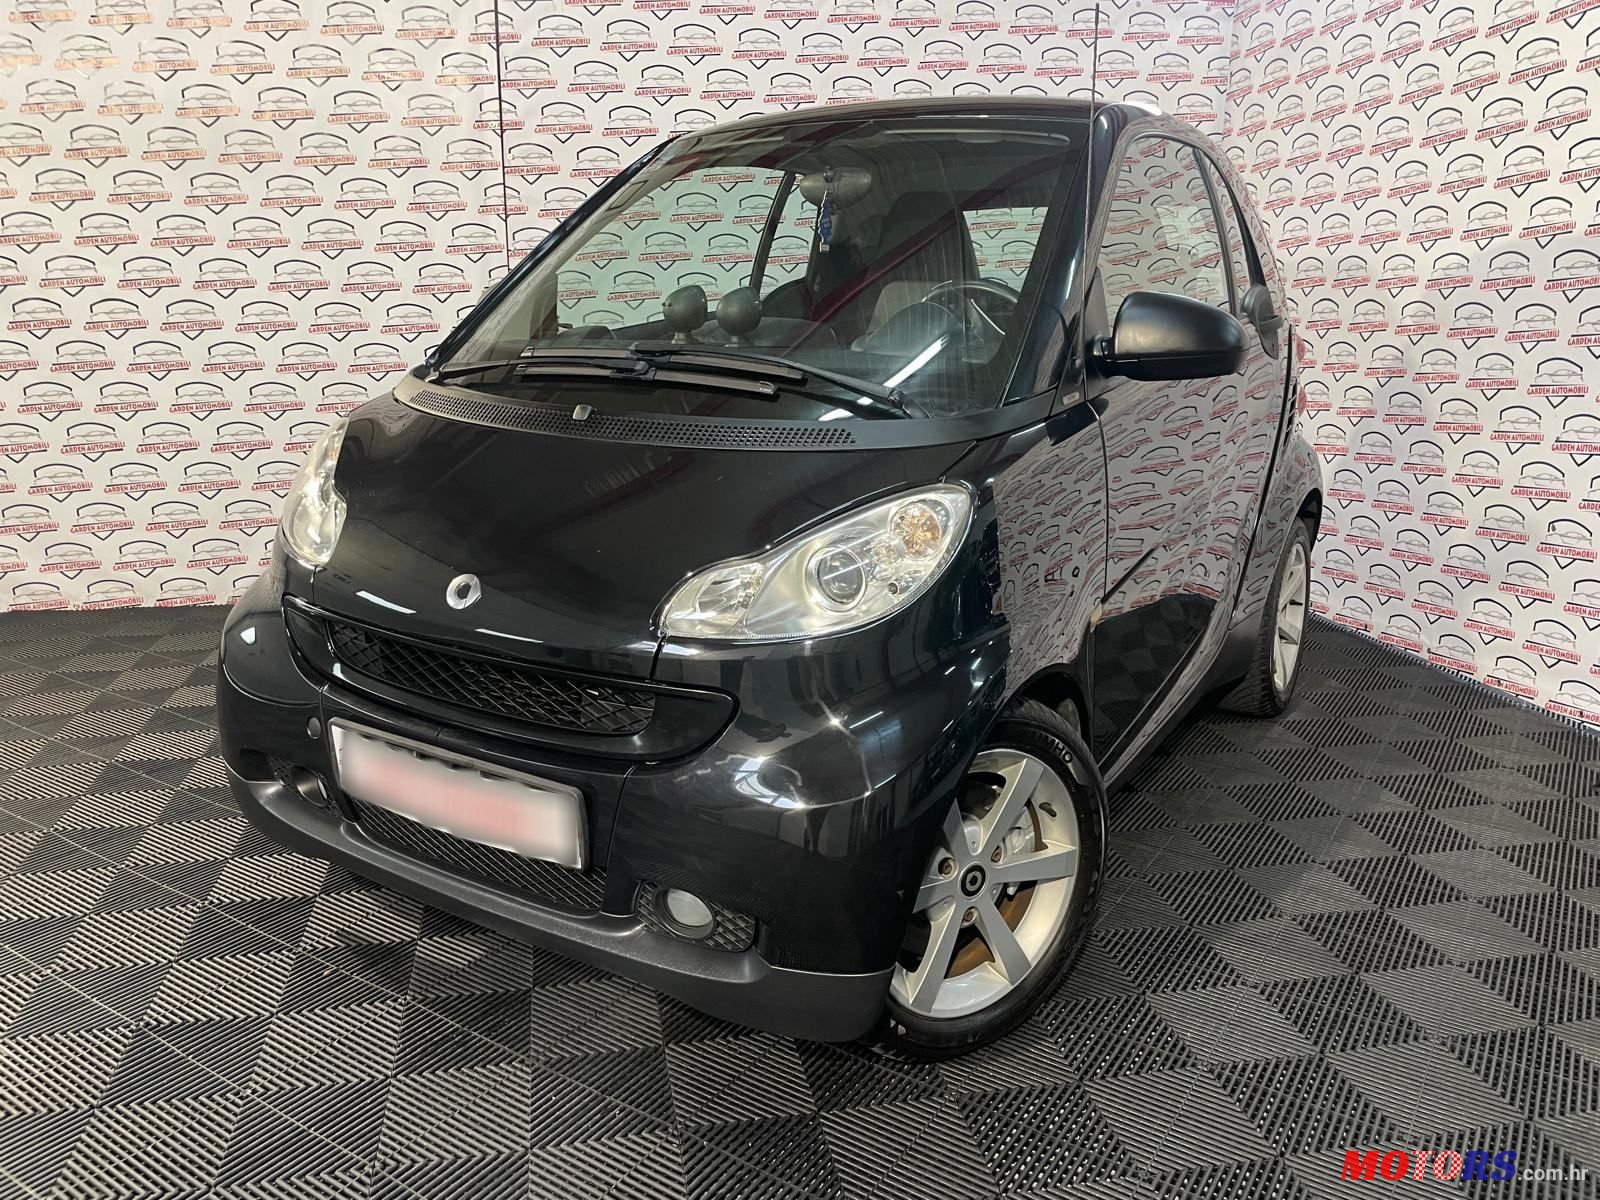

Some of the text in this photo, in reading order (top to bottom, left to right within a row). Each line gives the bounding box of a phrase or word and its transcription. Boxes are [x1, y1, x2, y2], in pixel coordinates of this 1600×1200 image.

[1540, 222, 1576, 235] AUTOMOBILI
[1466, 327, 1498, 337] AUTOMOBILI
[1525, 330, 1559, 340] AUTOMOBILI
[1430, 373, 1460, 381] AUTOMOBILI
[1485, 379, 1519, 388] AUTOMOBILI
[1550, 385, 1588, 394] AUTOMOBILI
[1452, 424, 1483, 432] AUTOMOBILI
[1510, 433, 1544, 442] AUTOMOBILI
[1418, 465, 1447, 474] AUTOMOBILI
[1471, 477, 1503, 486] AUTOMOBILI
[1533, 489, 1570, 499] AUTOMOBILI
[1438, 517, 1469, 527] AUTOMOBILI
[1496, 531, 1530, 542] AUTOMOBILI
[1559, 547, 1598, 560] AUTOMOBILI
[1459, 569, 1490, 581] AUTOMOBILI
[1520, 587, 1555, 601] AUTOMOBILI
[1428, 605, 1458, 617] AUTOMOBILI
[1483, 624, 1515, 639] AUTOMOBILI
[1544, 647, 1581, 663] AUTOMOBILI
[1447, 659, 1477, 673] AUTOMOBILI
